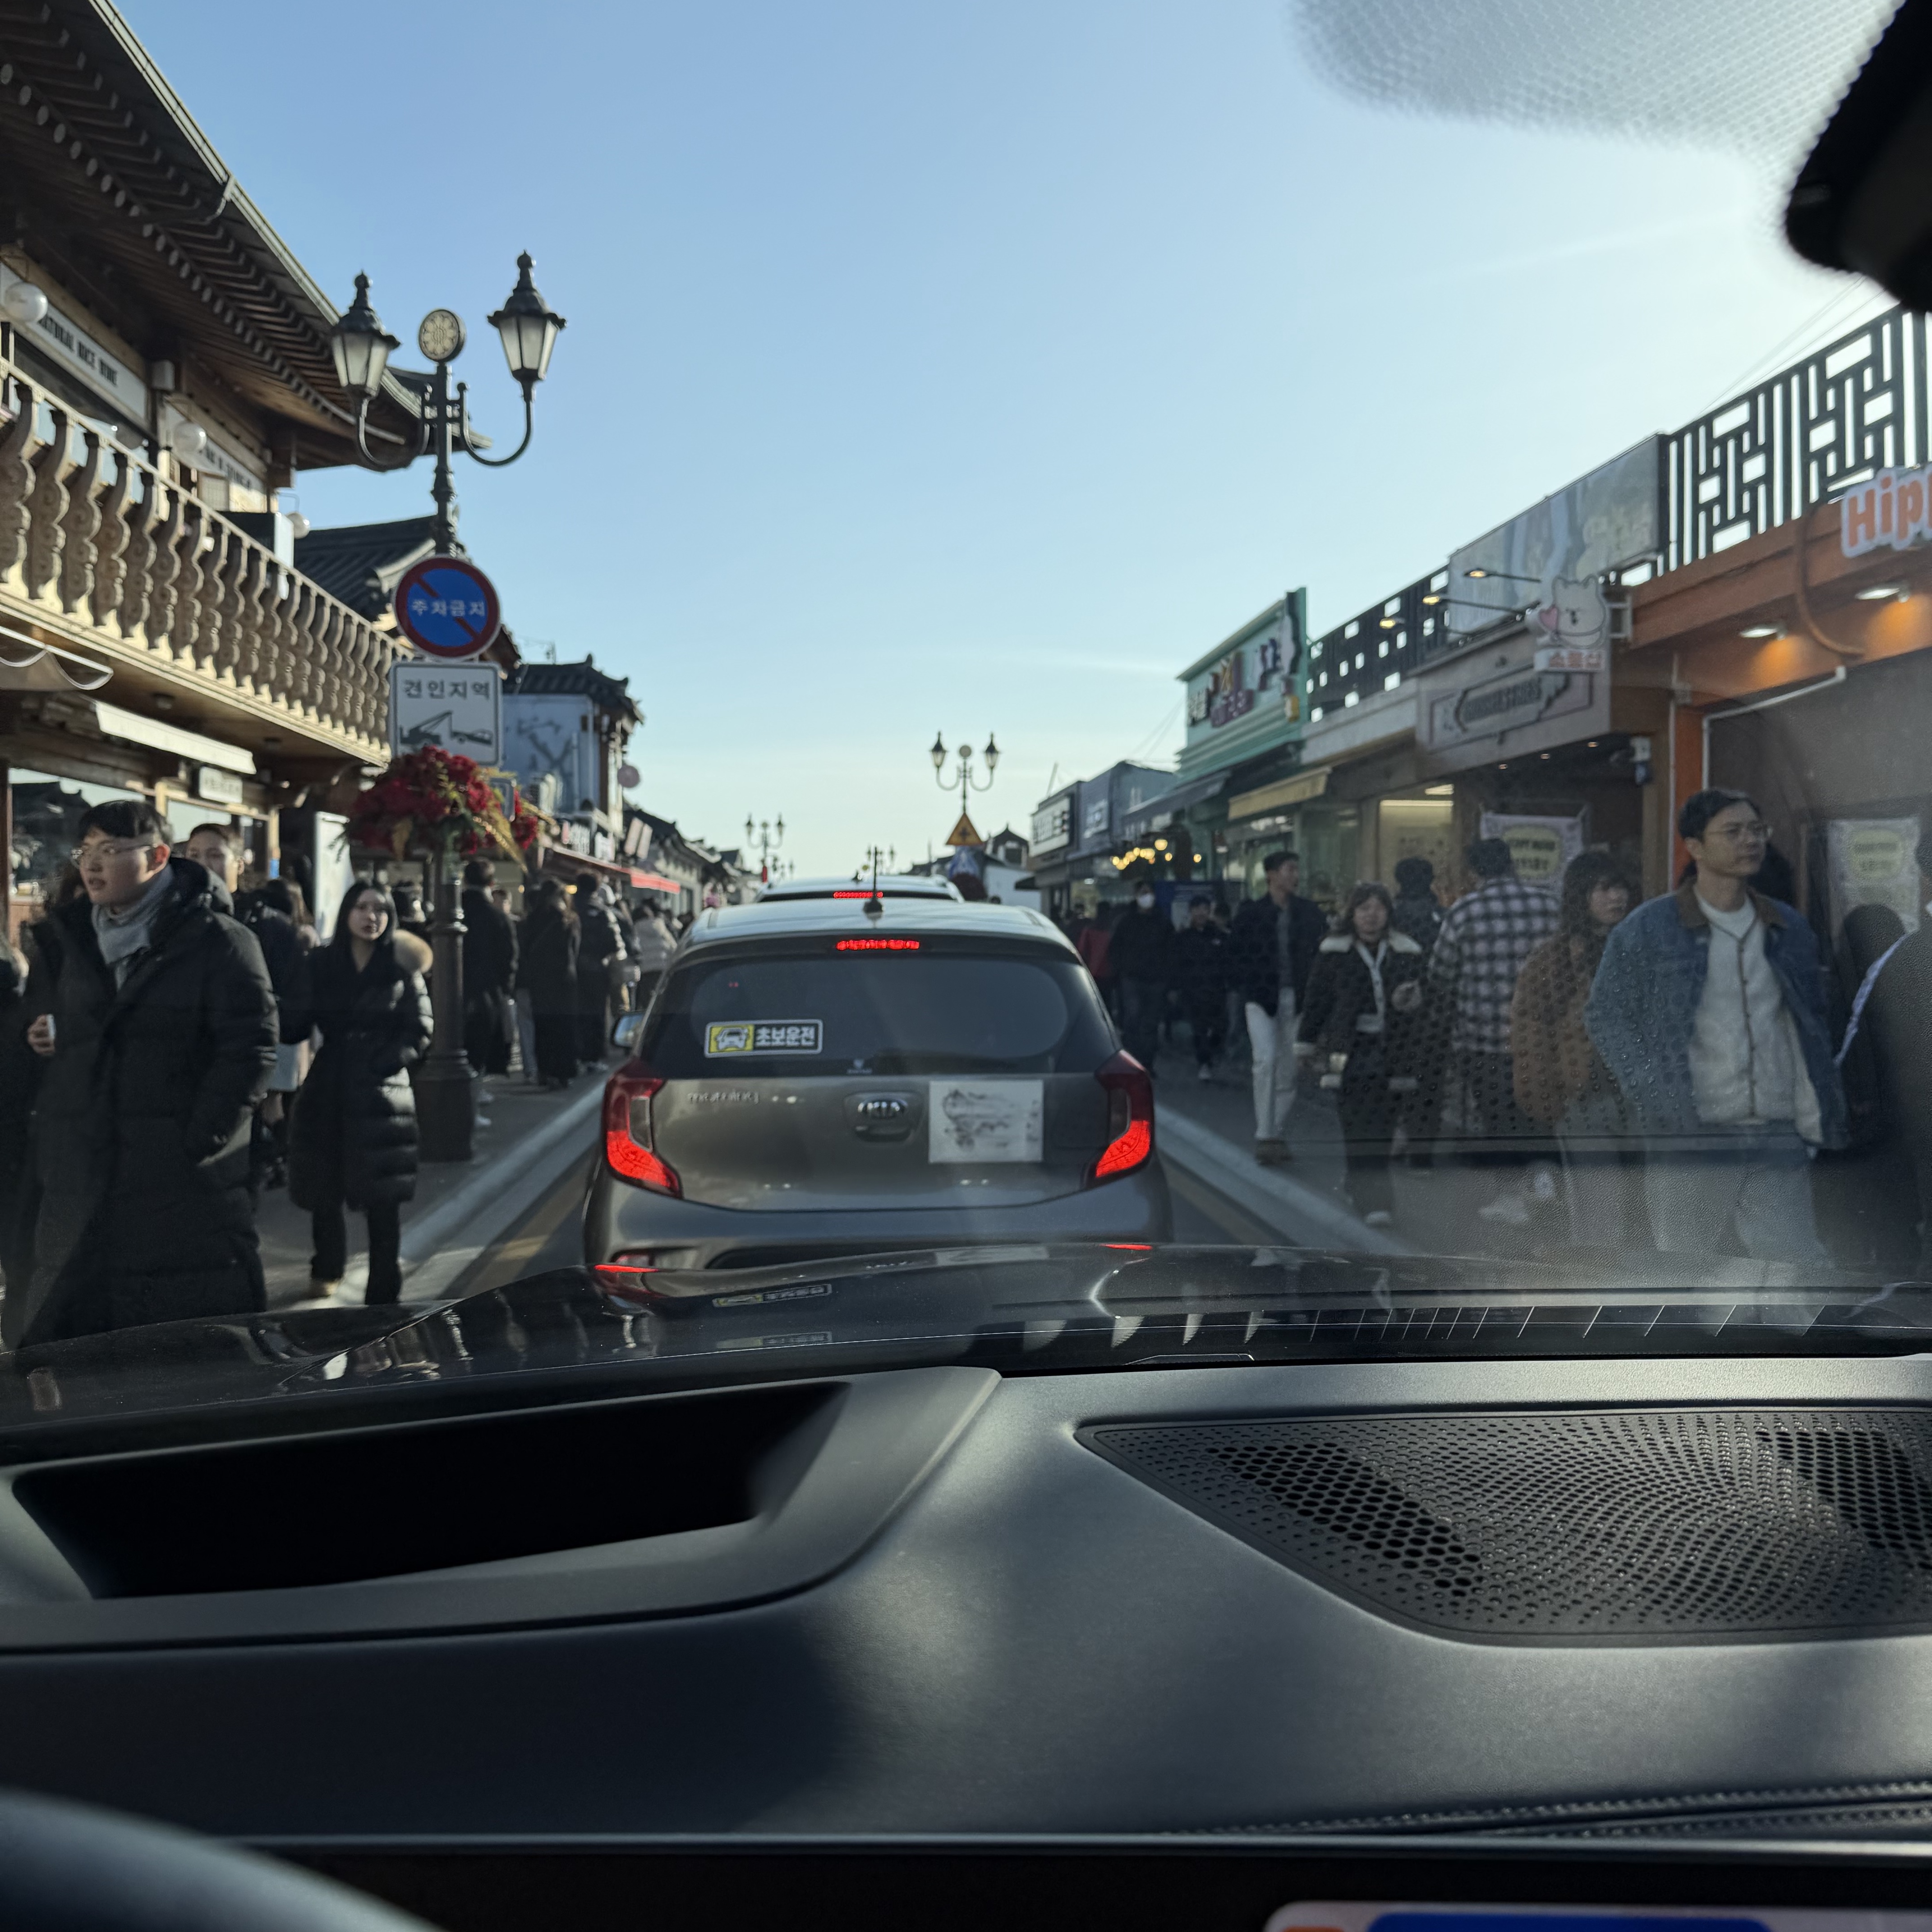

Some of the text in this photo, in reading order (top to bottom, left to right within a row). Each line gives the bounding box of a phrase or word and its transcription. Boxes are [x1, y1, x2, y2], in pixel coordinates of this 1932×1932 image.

[1848, 471, 1932, 547] Hip
[411, 599, 486, 617] 주차금지
[404, 678, 491, 700] 견인지역
[755, 1026, 815, 1048] 초보운전
